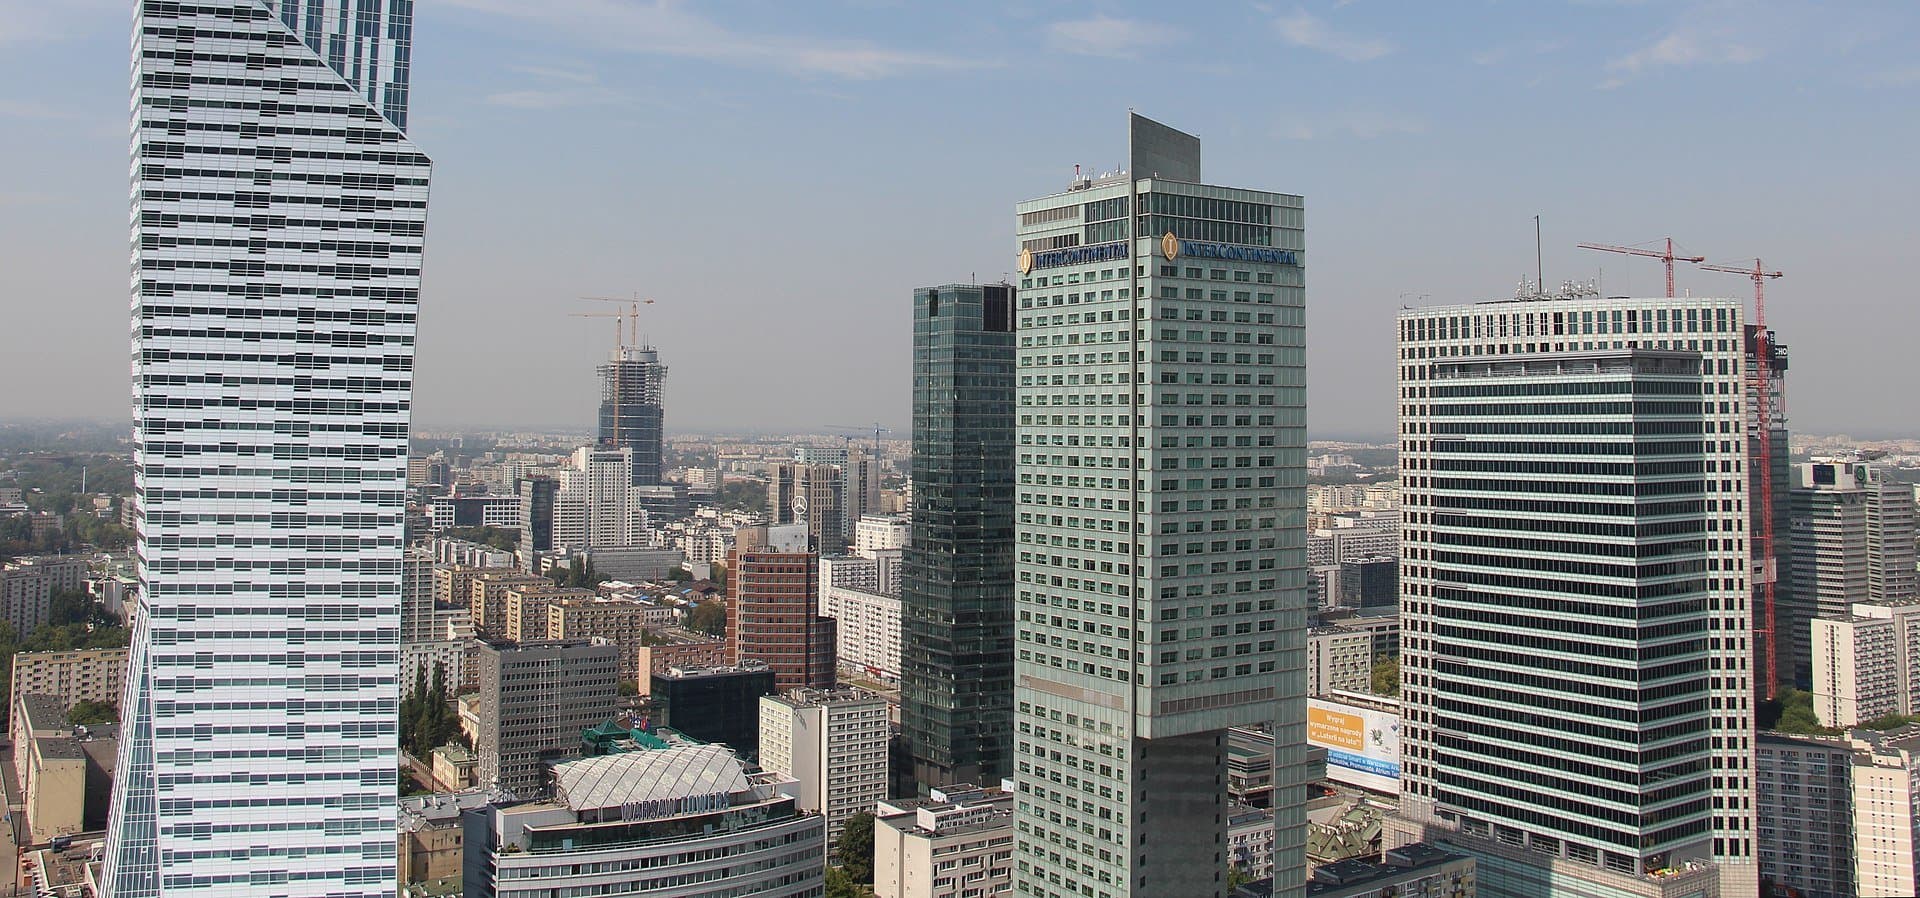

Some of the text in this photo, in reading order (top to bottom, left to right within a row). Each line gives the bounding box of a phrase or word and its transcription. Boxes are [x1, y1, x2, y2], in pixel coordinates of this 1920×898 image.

[1327, 714, 1344, 725] Wygraj
[621, 791, 729, 821] WARSAW TOWERS
